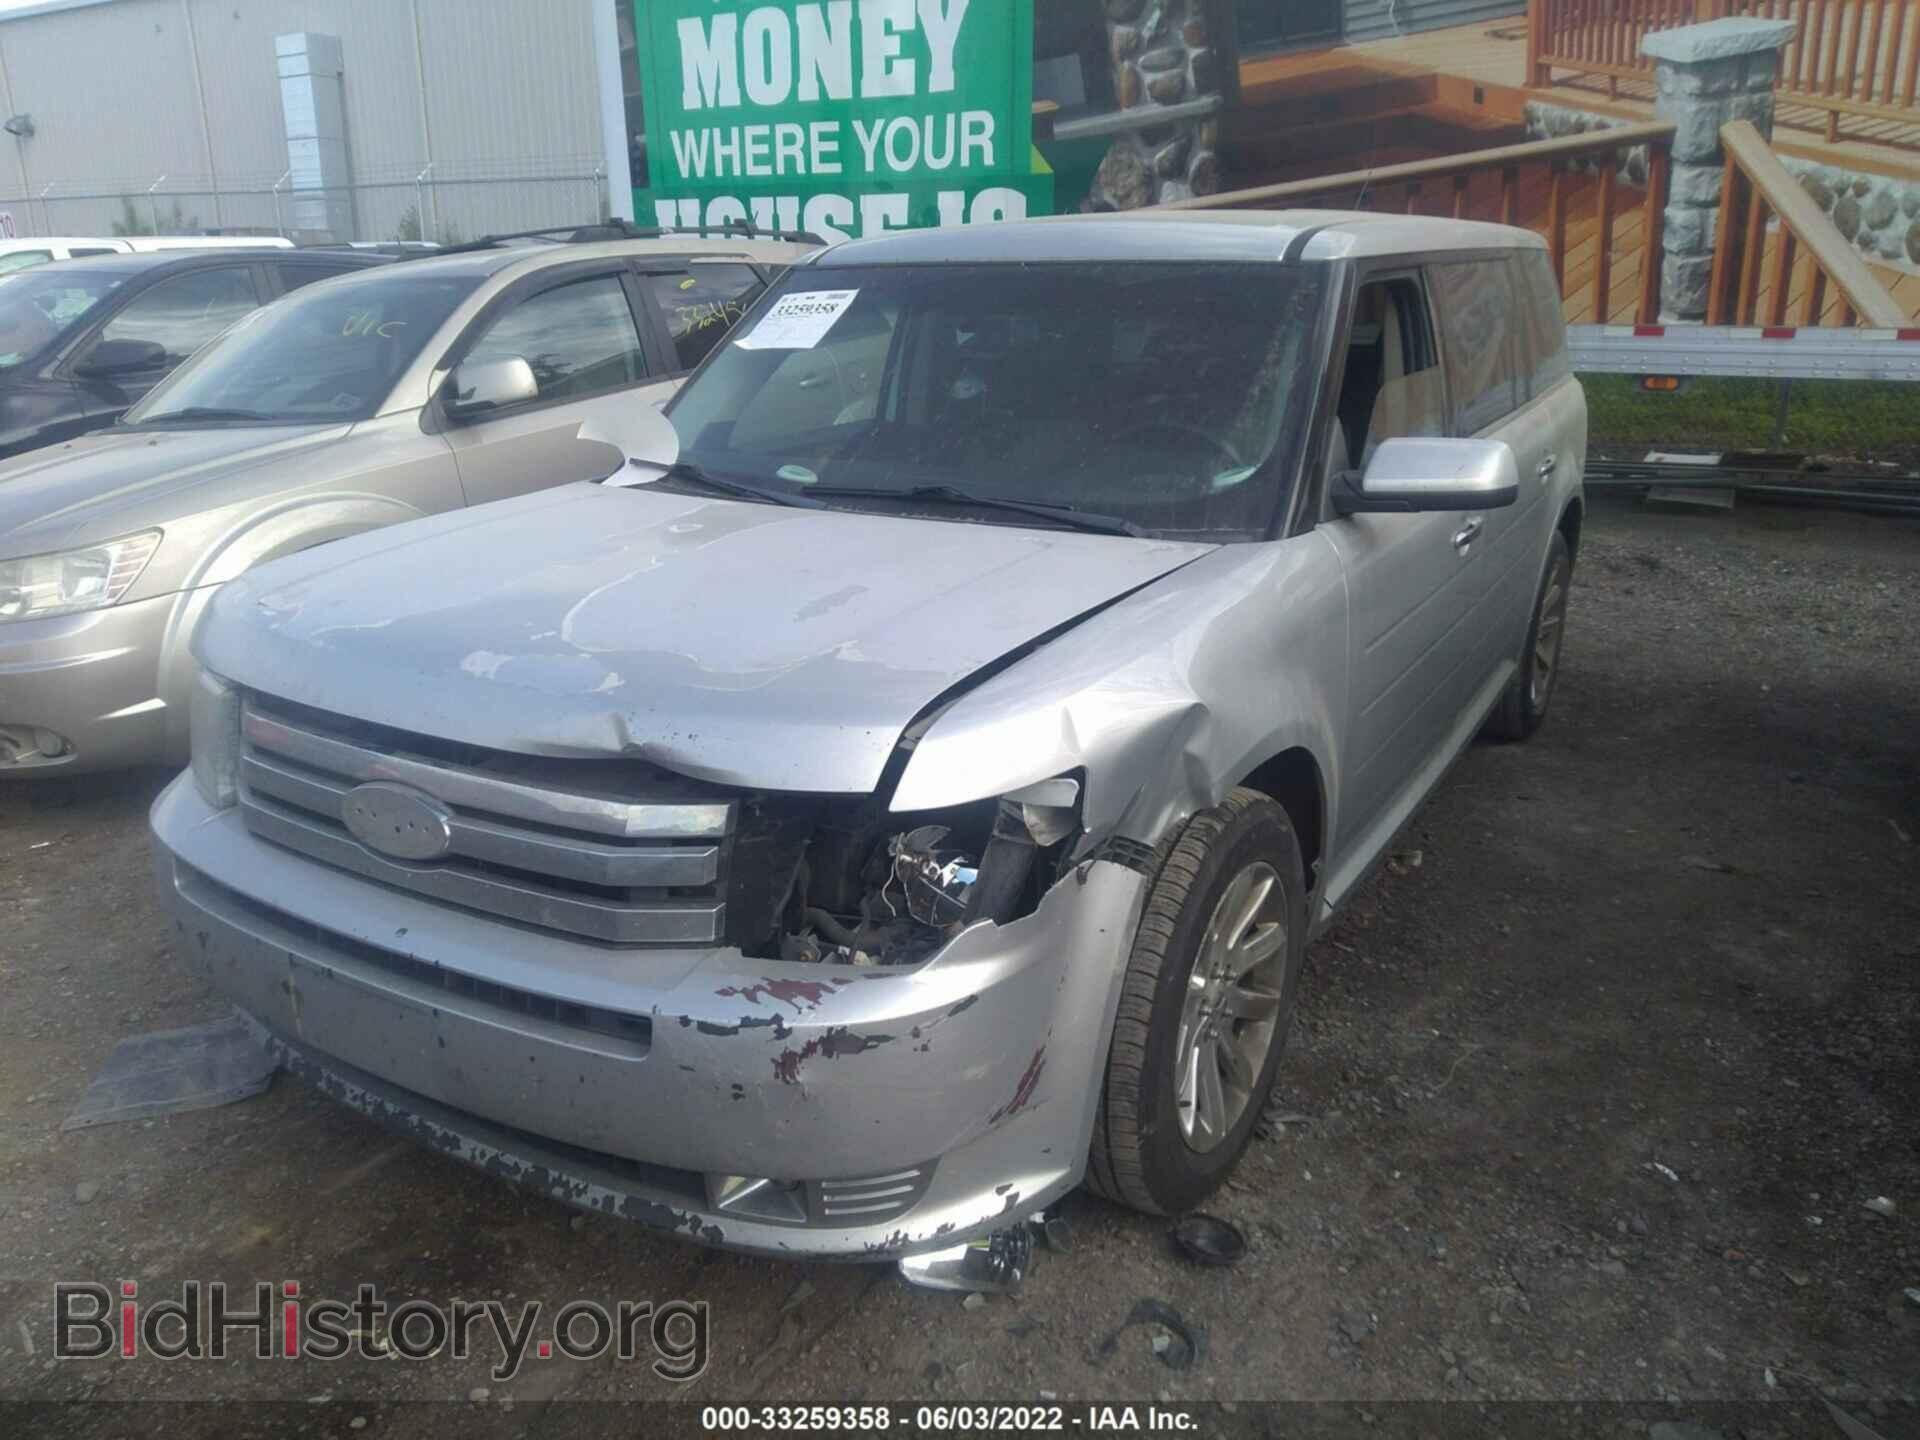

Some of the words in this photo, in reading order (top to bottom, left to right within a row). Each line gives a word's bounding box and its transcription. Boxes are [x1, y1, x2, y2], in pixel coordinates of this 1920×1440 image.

[677, 0, 969, 110] MONEY
[670, 121, 842, 178] WHERE
[852, 110, 995, 173] YOUR
